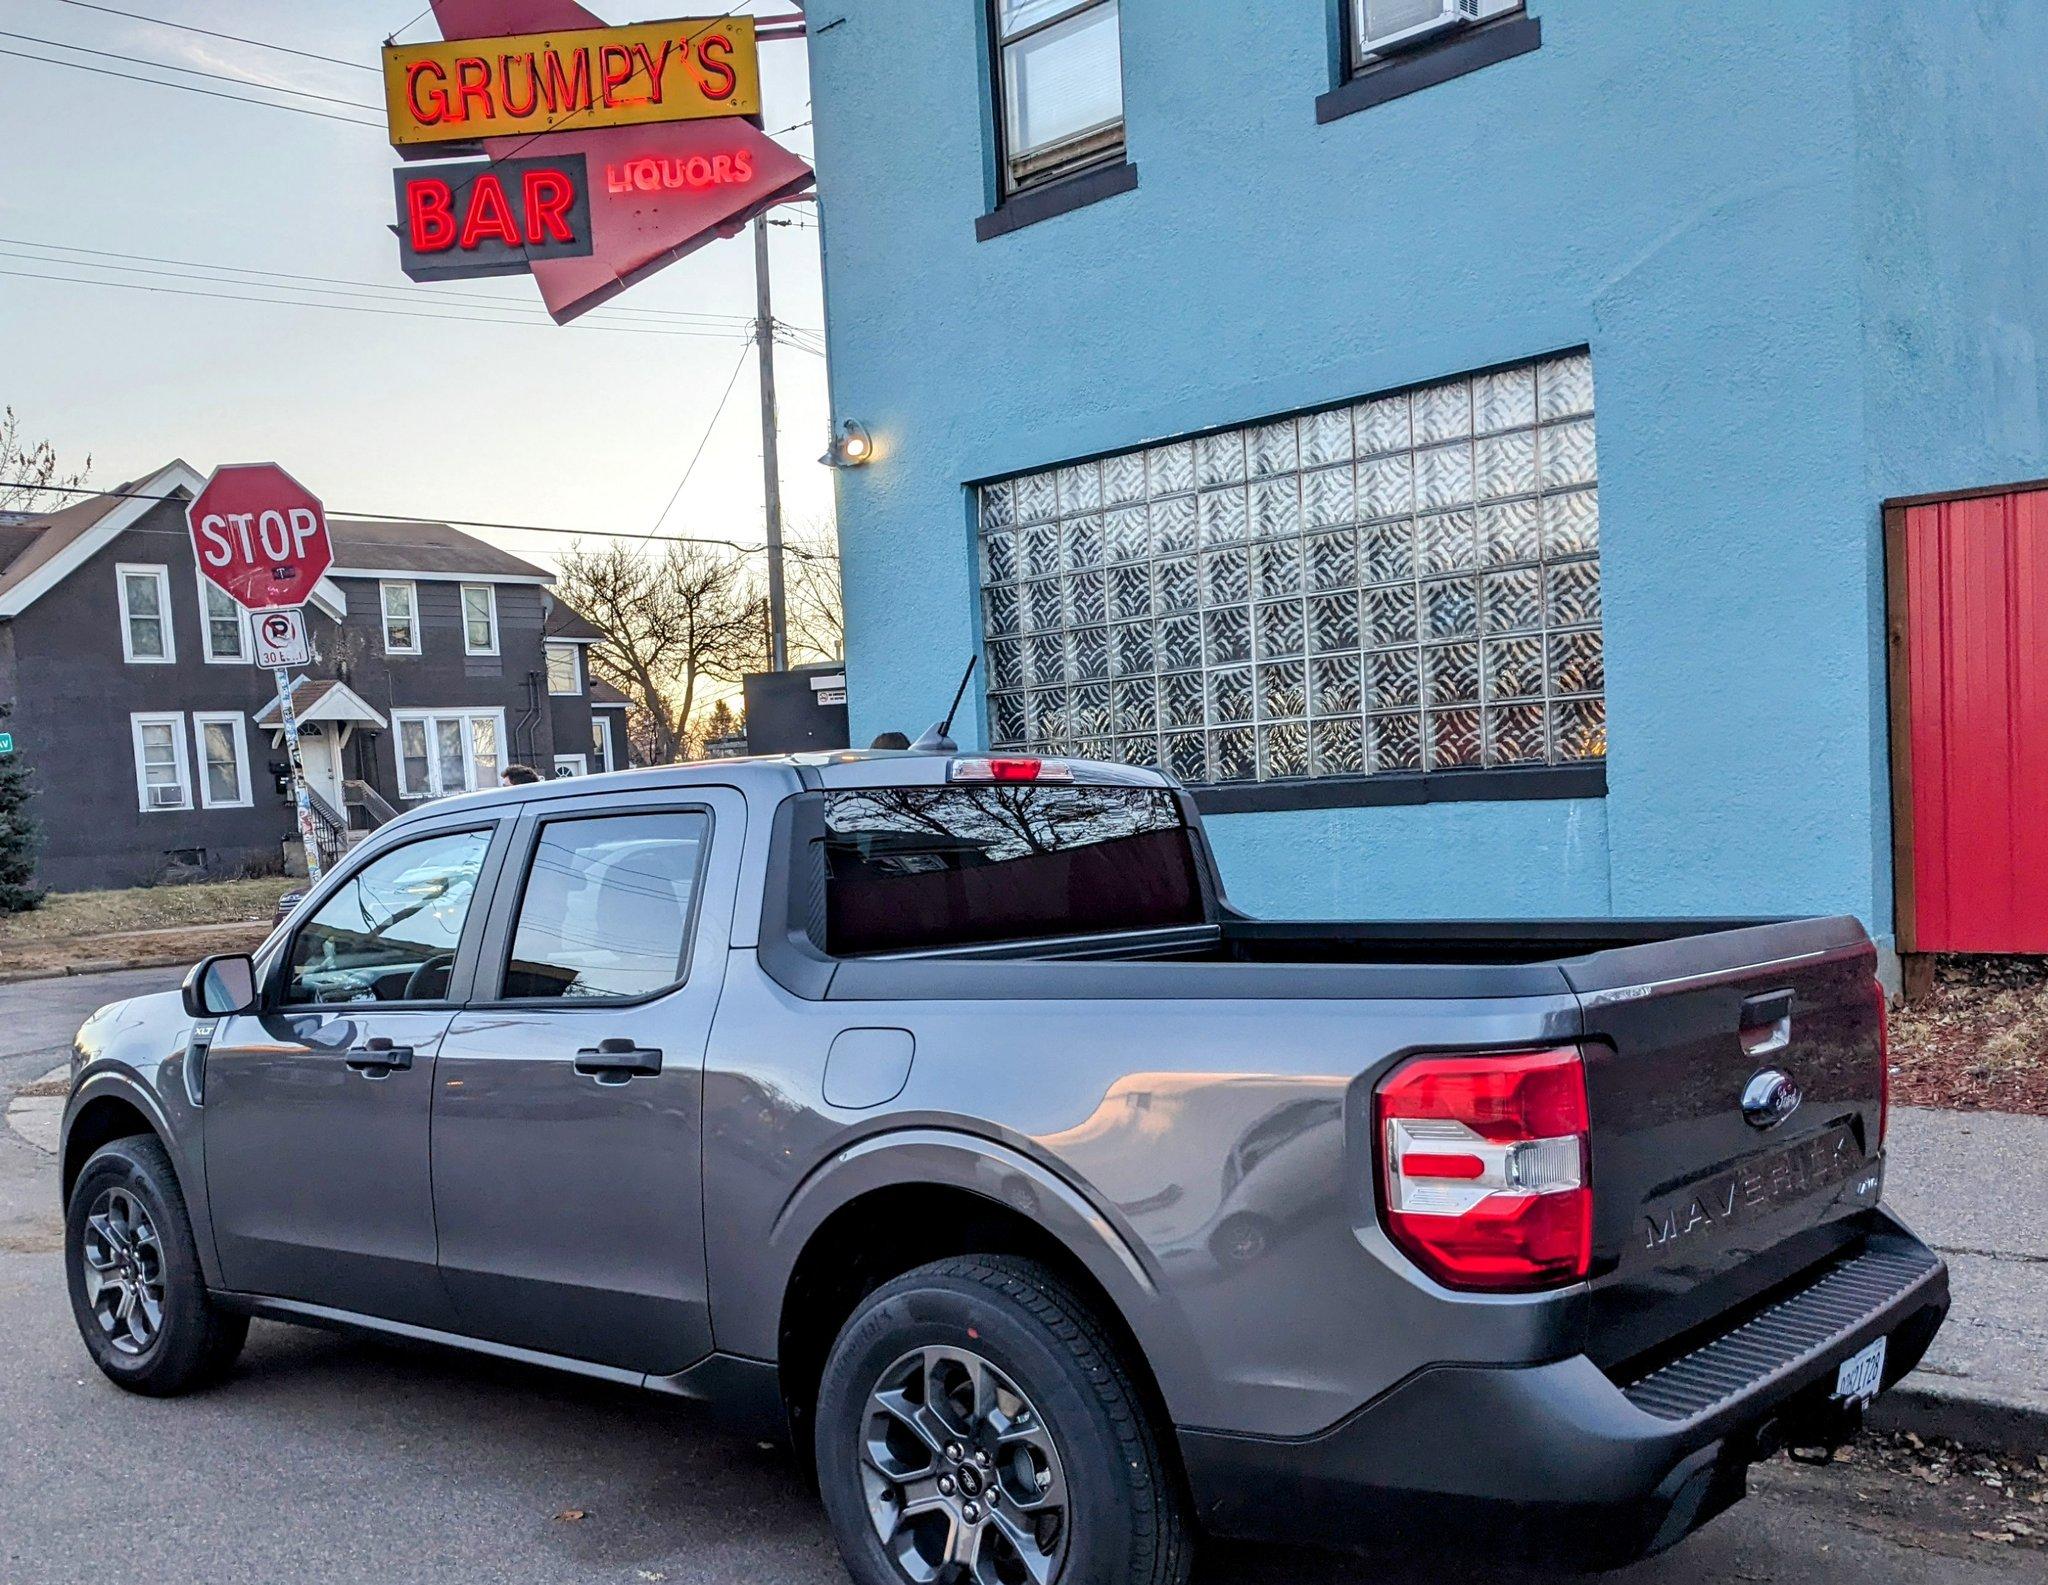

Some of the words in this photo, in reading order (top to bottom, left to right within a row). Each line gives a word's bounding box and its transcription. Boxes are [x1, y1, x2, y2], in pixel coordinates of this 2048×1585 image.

[406, 34, 736, 125] GRUMPY'S
[607, 150, 753, 193] LIQUORS
[407, 168, 576, 253] BAR
[201, 508, 318, 567] STOP
[263, 651, 277, 663] 30
[194, 1026, 214, 1036] XLT
